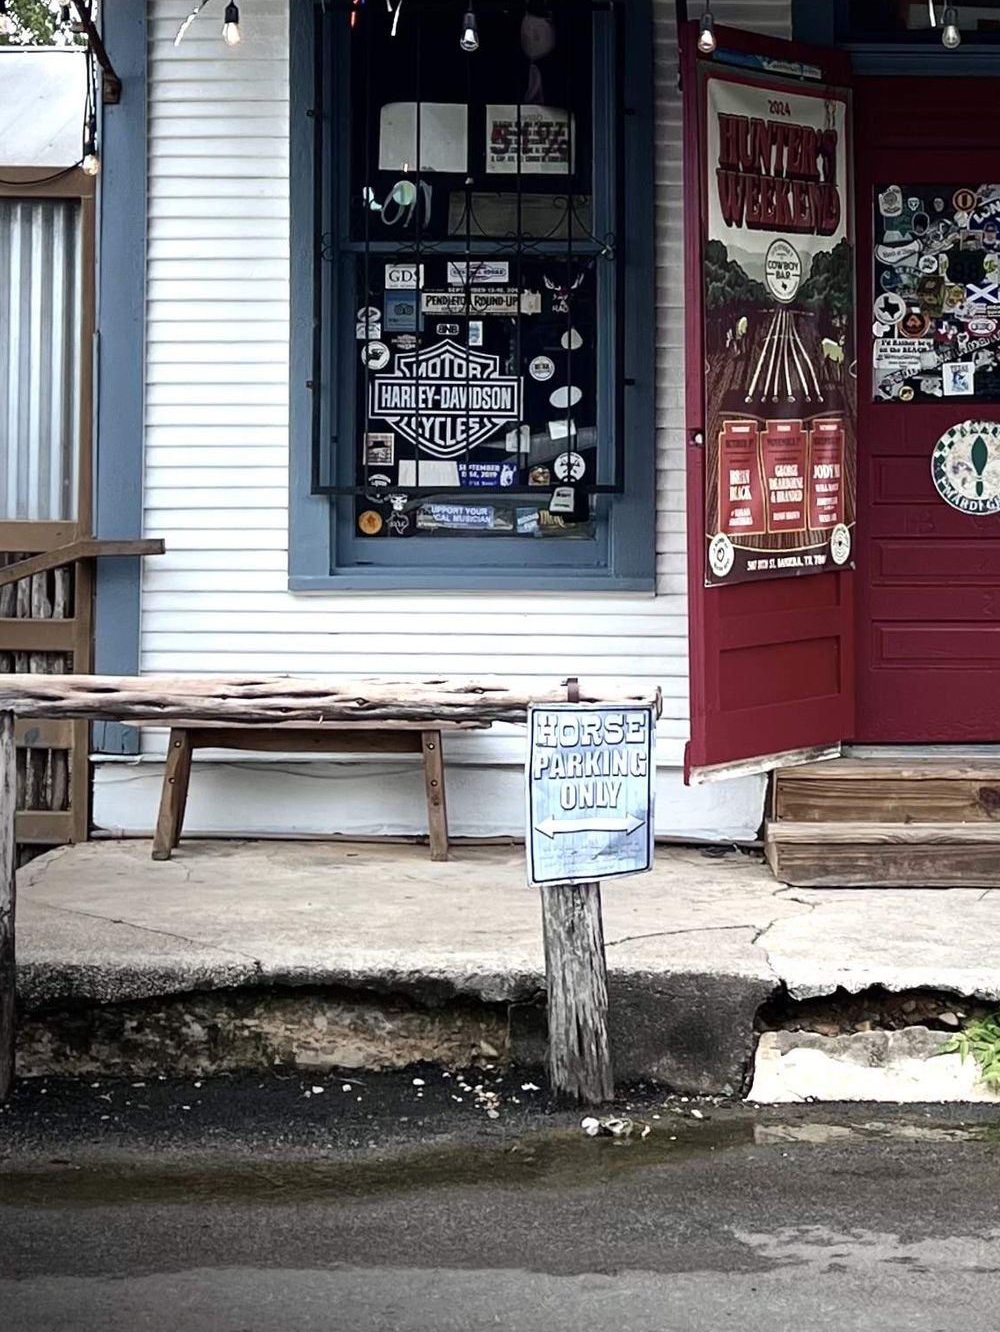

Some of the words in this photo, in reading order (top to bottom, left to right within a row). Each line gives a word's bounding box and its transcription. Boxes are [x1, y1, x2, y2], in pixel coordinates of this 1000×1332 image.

[768, 99, 791, 116] 2024
[716, 169, 841, 237] WEEKEND
[767, 260, 799, 270] COWBOY
[775, 270, 791, 279] BAR
[425, 294, 468, 307] PENDLETO
[473, 295, 519, 306] ROUND-UP
[413, 352, 482, 379] MOTOR
[381, 385, 512, 410] HARLEY-DAVIDSON
[411, 416, 480, 446] CYCLES
[466, 506, 488, 516] YOUR
[943, 485, 983, 511] MARDI
[535, 713, 647, 749] HORSE
[533, 747, 647, 780] PARKING
[560, 779, 622, 810] ONLY
